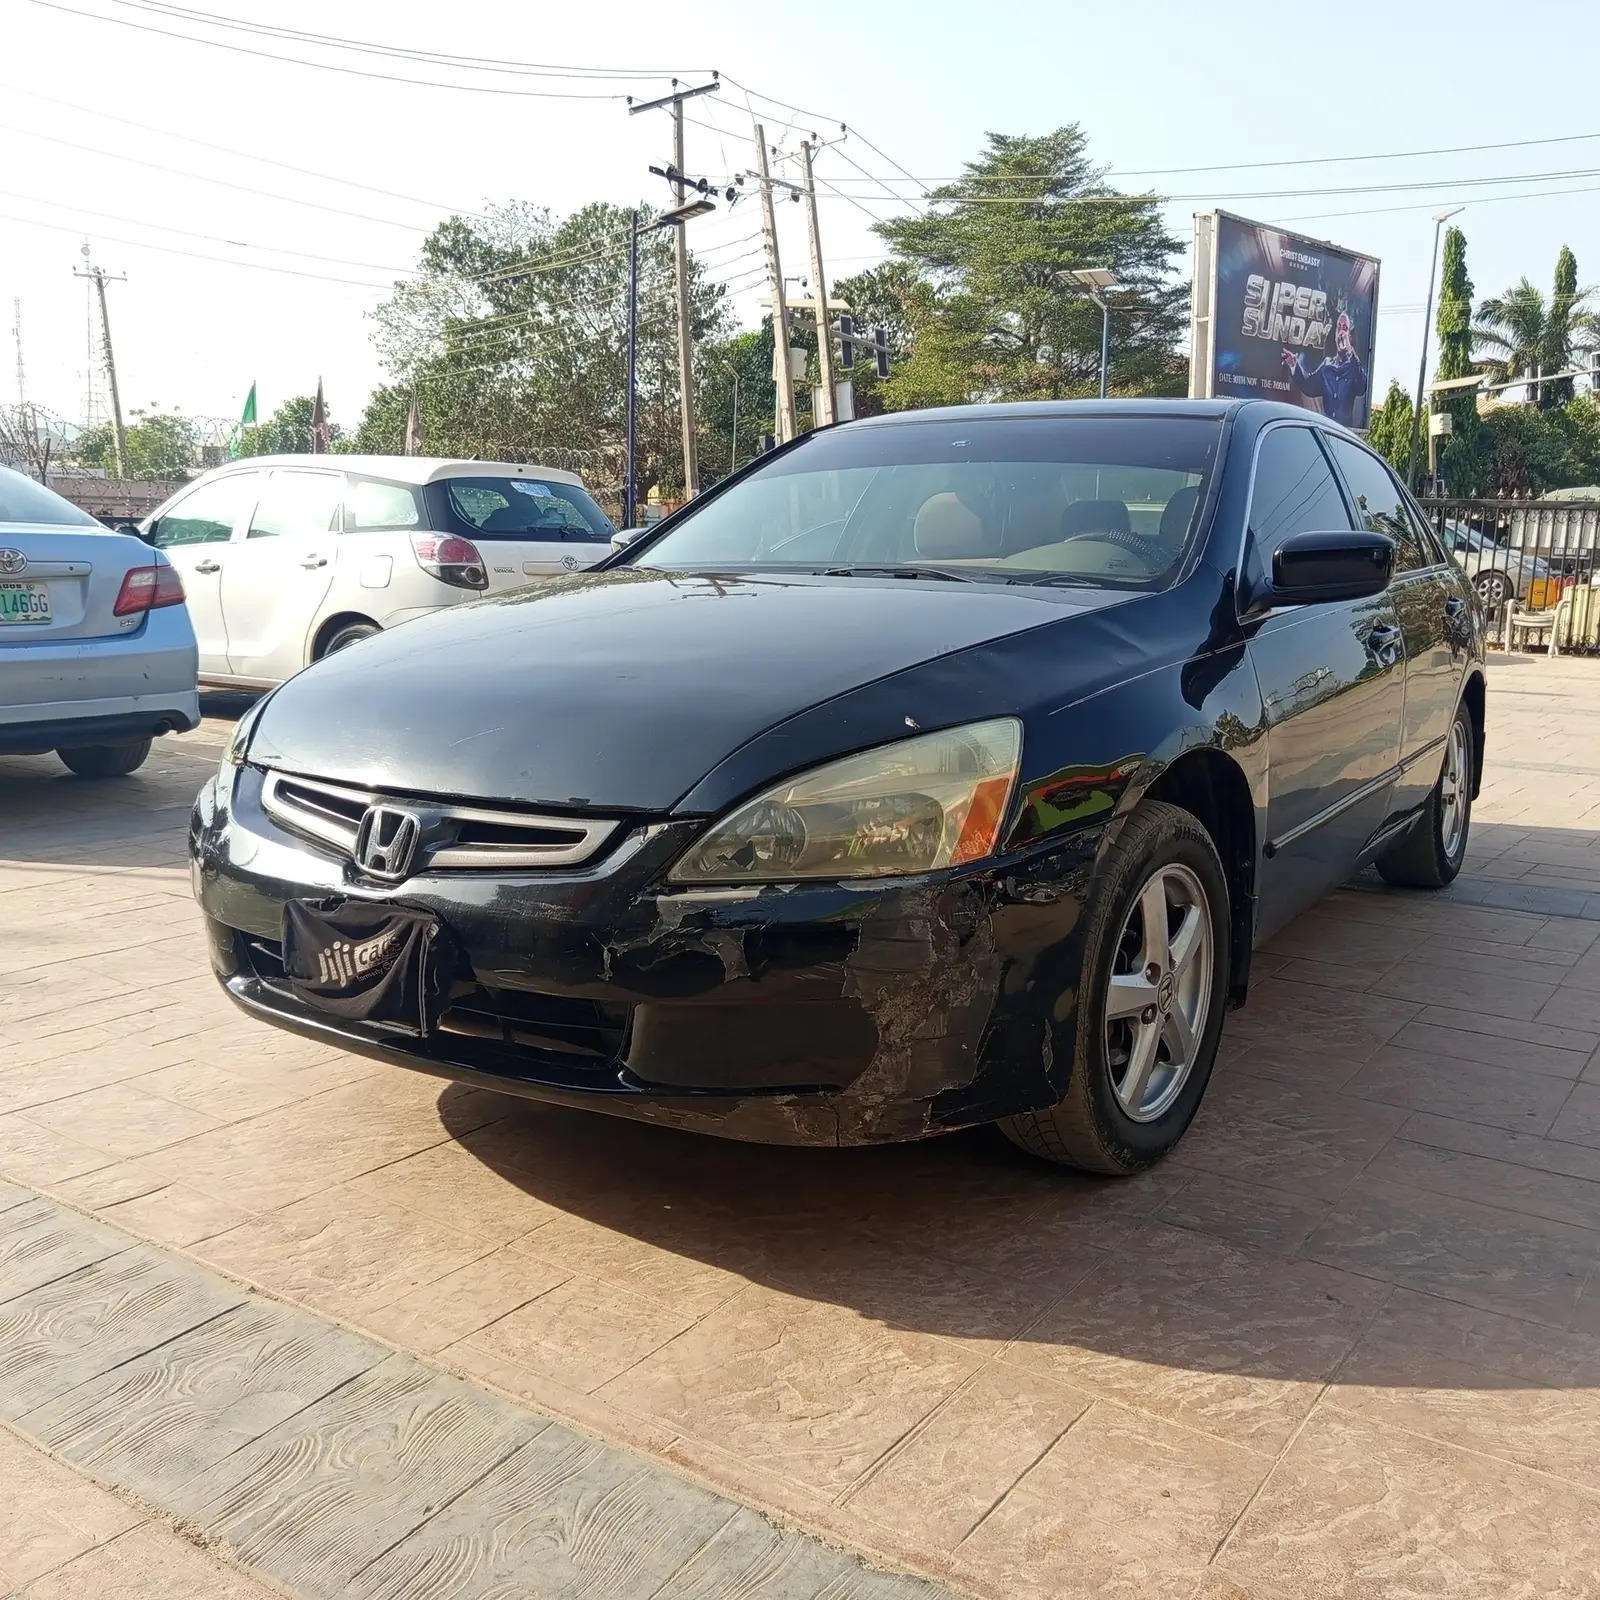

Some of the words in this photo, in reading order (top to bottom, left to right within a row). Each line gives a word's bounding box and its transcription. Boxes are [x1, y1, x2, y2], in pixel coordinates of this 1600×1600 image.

[1279, 248, 1298, 262] CHRIST
[1297, 252, 1321, 268] EMBASSY
[1244, 274, 1327, 323] SUPER
[1241, 306, 1333, 350] SUNDAY
[1246, 376, 1258, 386] NOV
